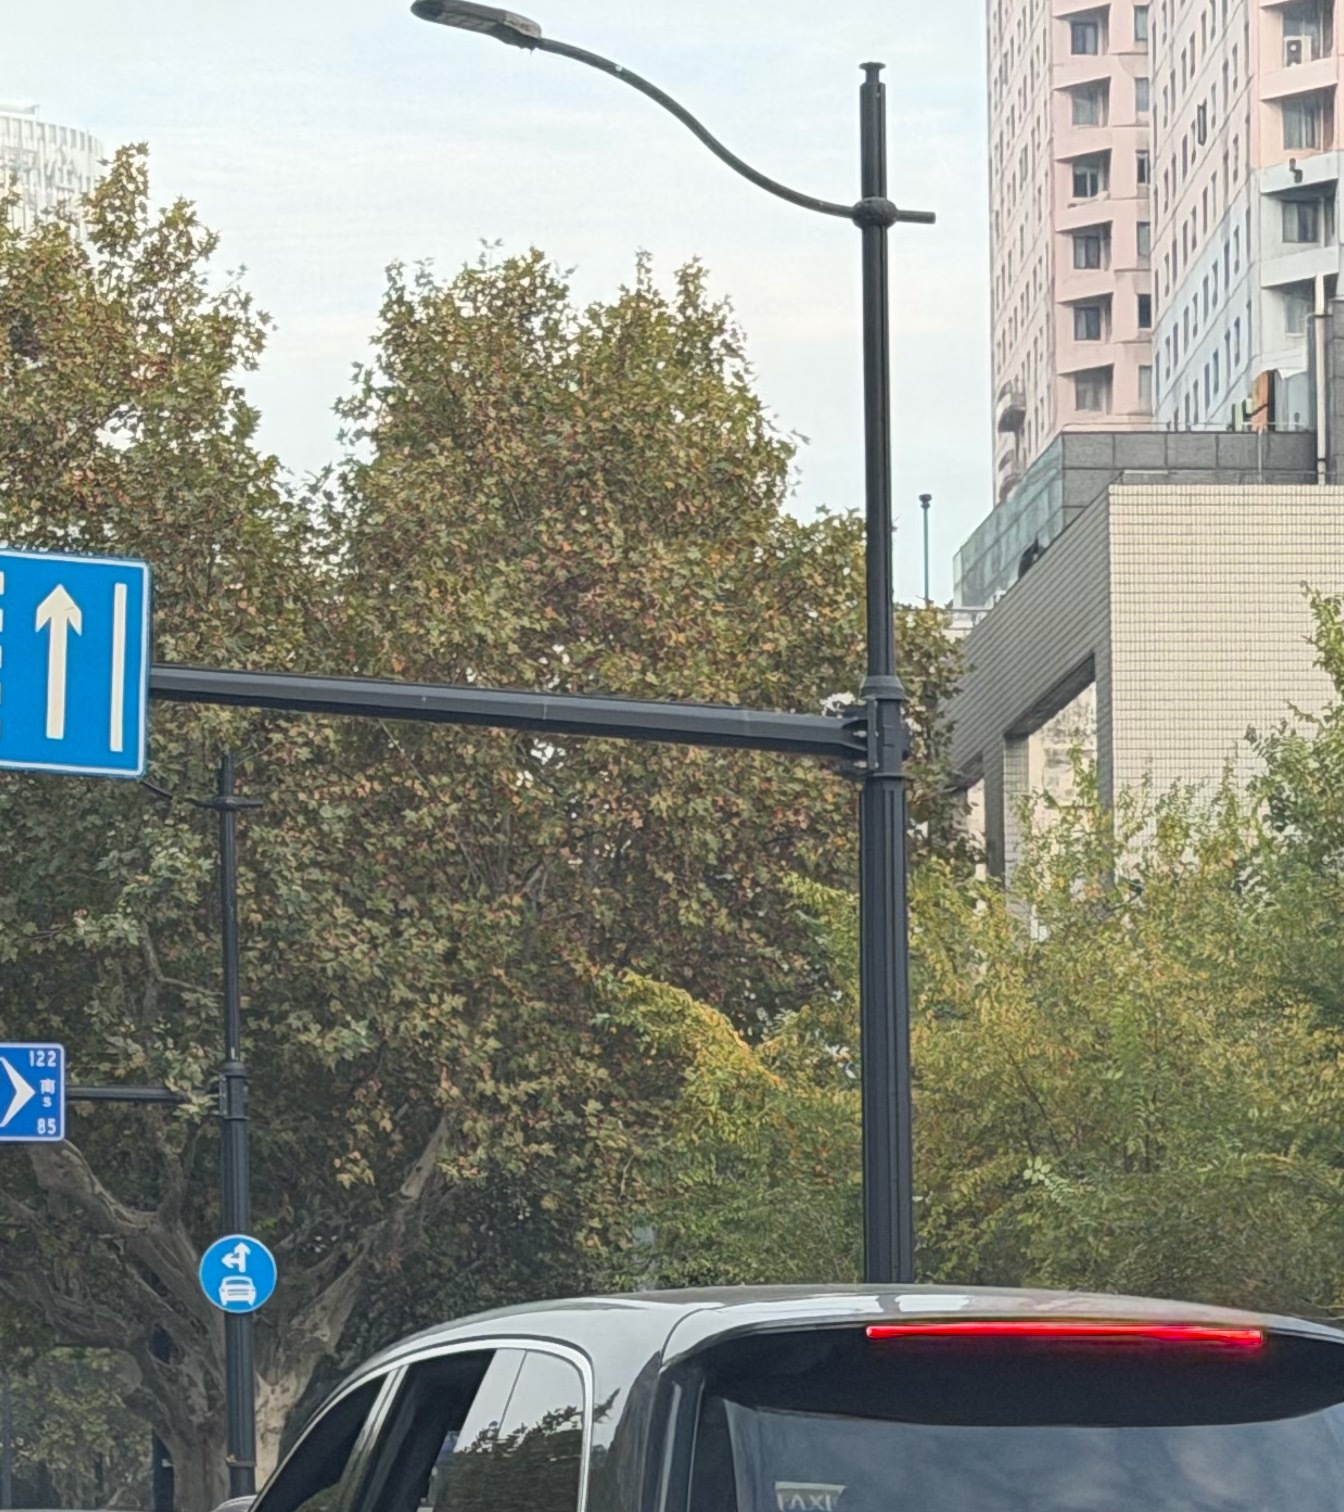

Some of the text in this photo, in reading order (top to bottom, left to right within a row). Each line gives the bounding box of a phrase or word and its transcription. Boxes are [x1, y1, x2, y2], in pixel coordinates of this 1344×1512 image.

[29, 1050, 56, 1067] 122
[40, 1079, 56, 1094] 南
[43, 1097, 52, 1107] S
[36, 1118, 56, 1134] 85
